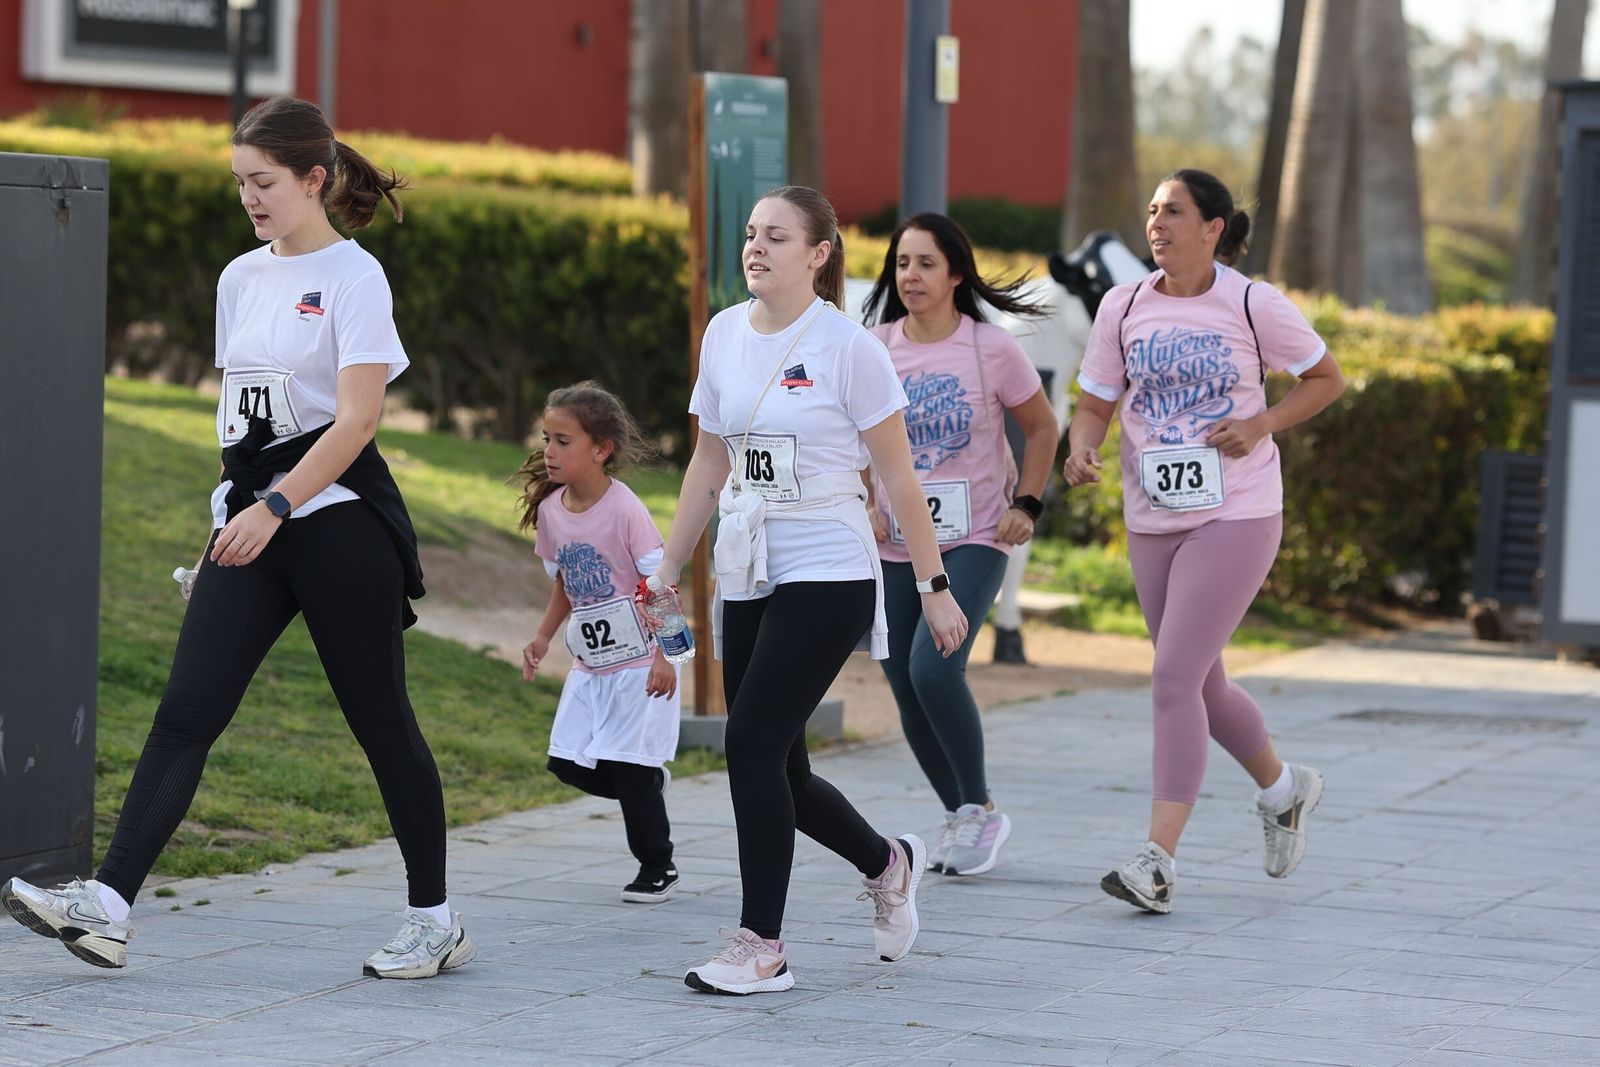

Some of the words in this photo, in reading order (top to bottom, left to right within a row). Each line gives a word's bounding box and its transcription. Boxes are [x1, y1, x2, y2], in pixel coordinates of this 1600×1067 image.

[1127, 328, 1222, 376] Mujeres
[1157, 372, 1175, 388] de
[1177, 354, 1219, 384] SOS
[238, 386, 272, 420] 471
[923, 394, 957, 418] SOS
[1131, 376, 1234, 420] ANIMAL
[744, 448, 775, 482] 103
[1156, 461, 1204, 492] 373
[580, 619, 616, 650] 92
